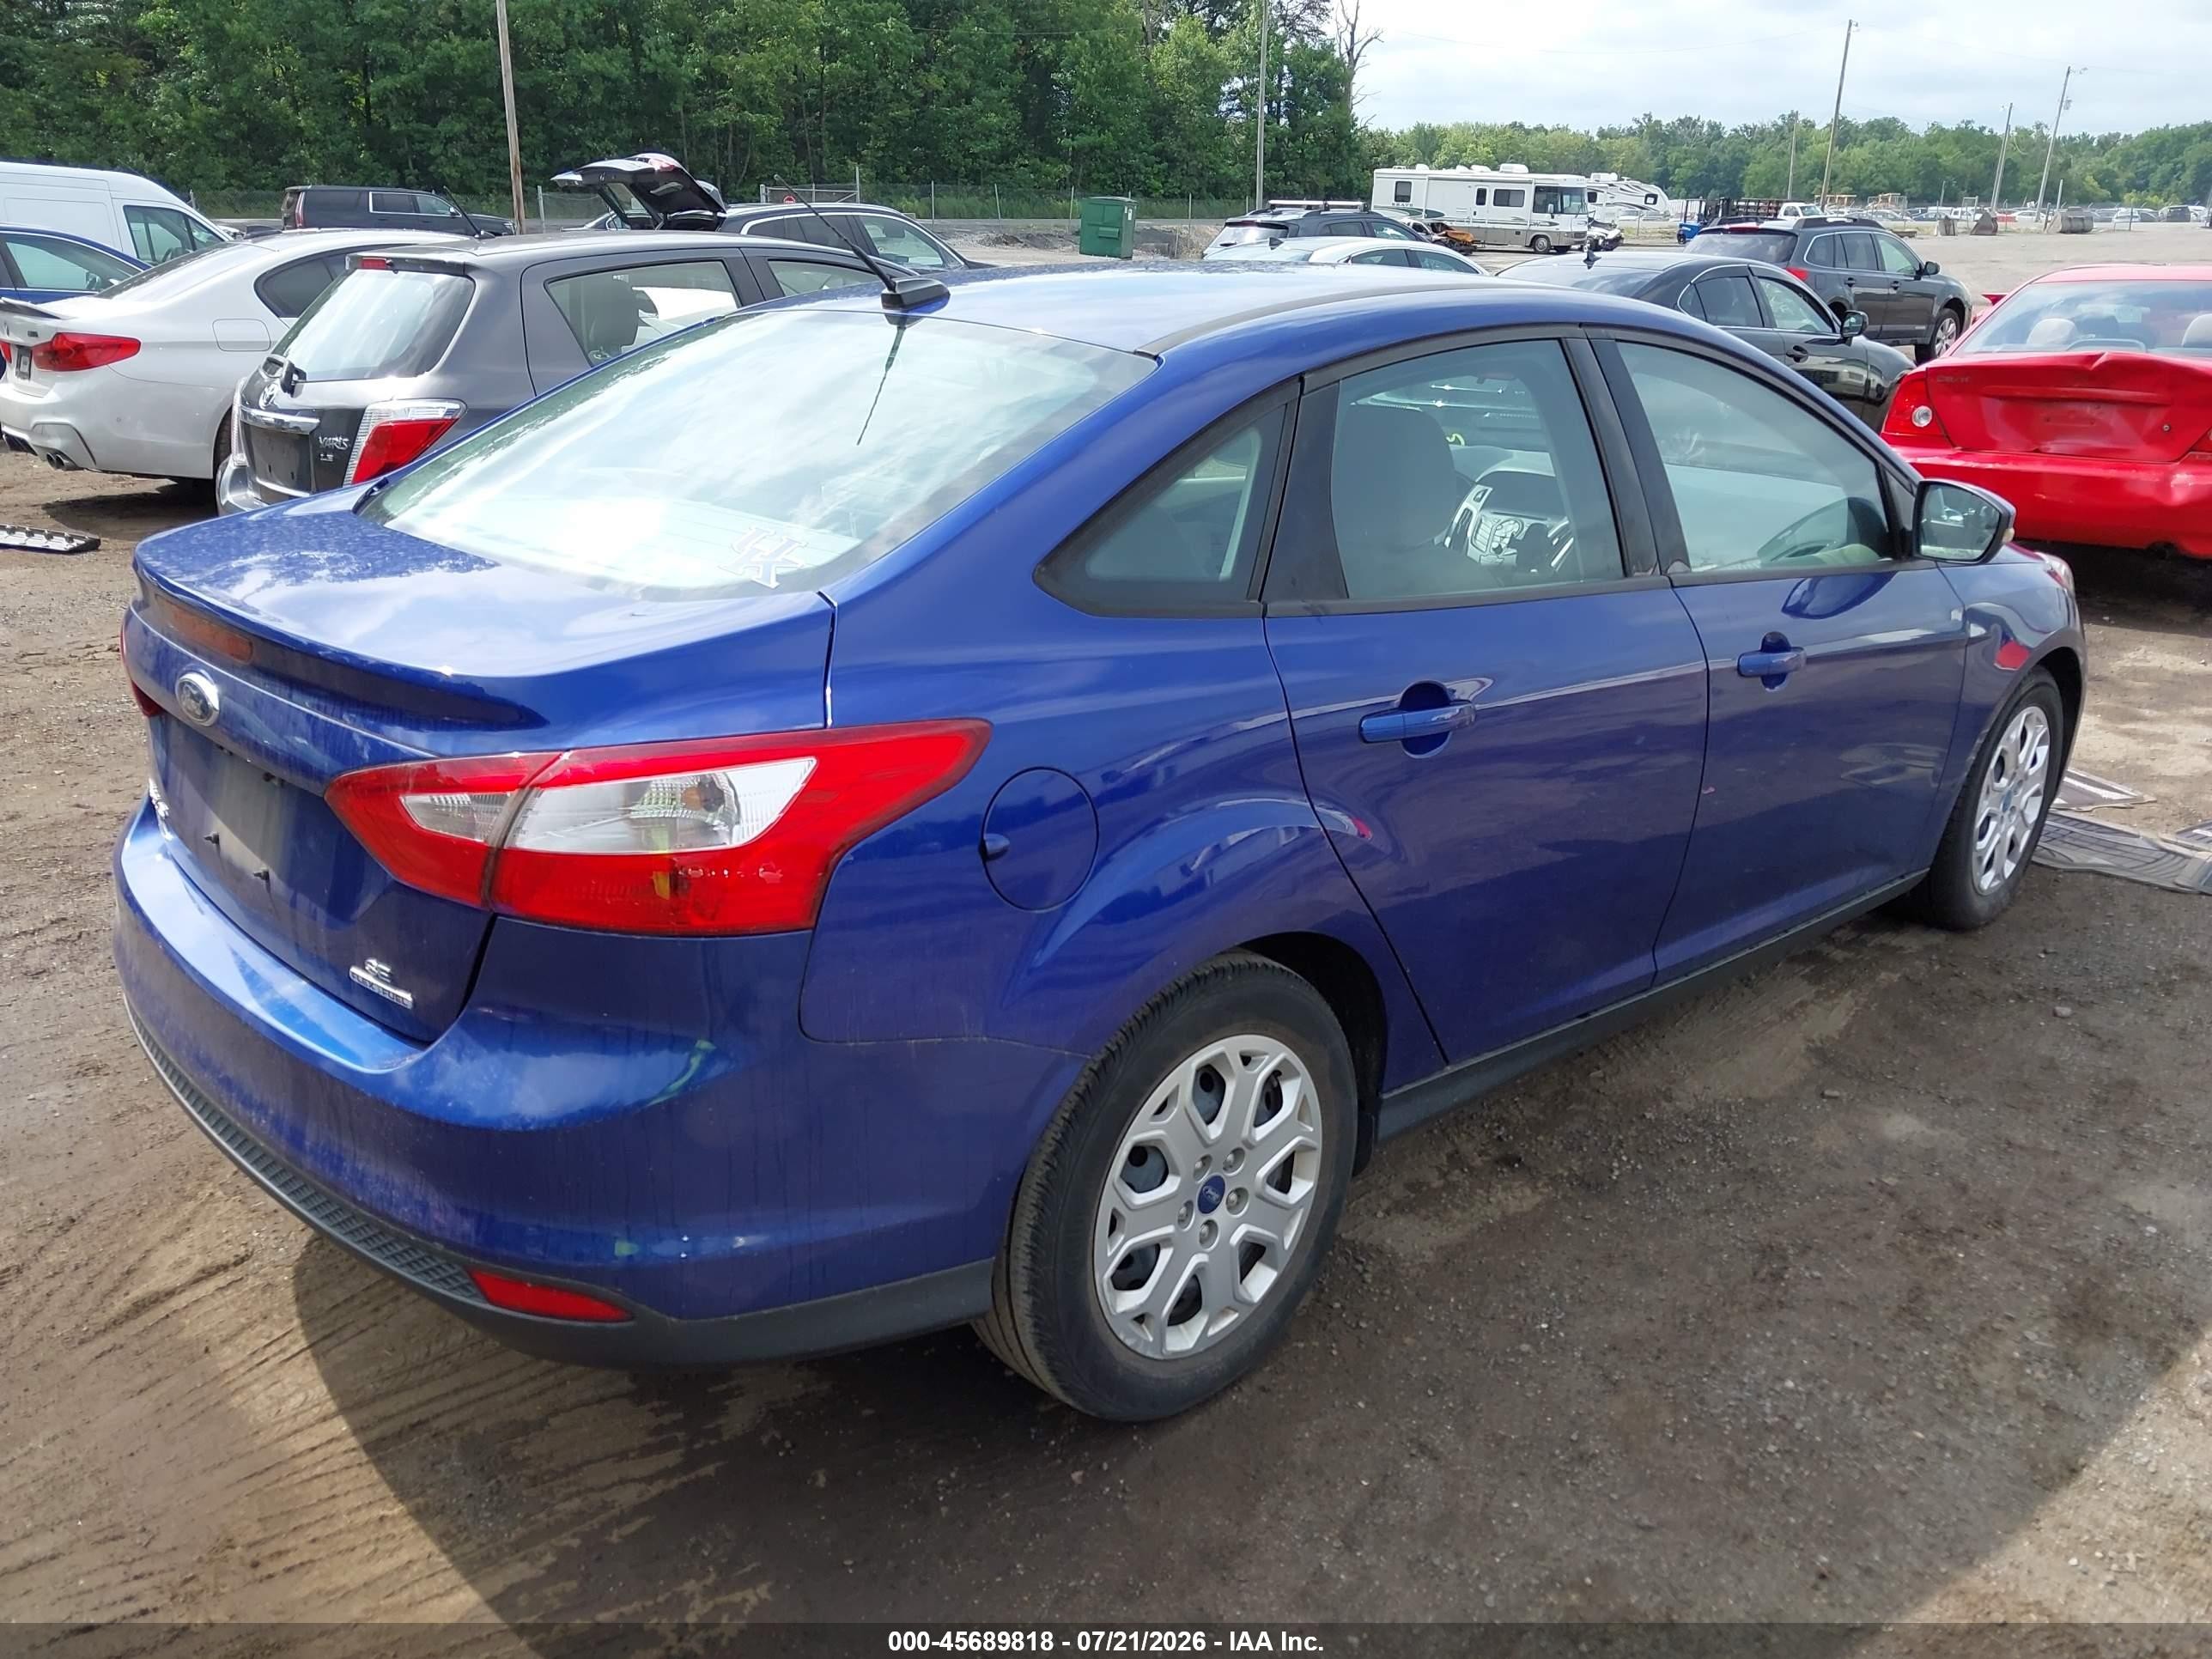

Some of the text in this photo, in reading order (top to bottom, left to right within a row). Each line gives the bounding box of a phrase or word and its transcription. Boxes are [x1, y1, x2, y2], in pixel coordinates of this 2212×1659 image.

[319, 436, 349, 450] YARIS
[319, 453, 334, 462] LE
[365, 957, 392, 983] SE
